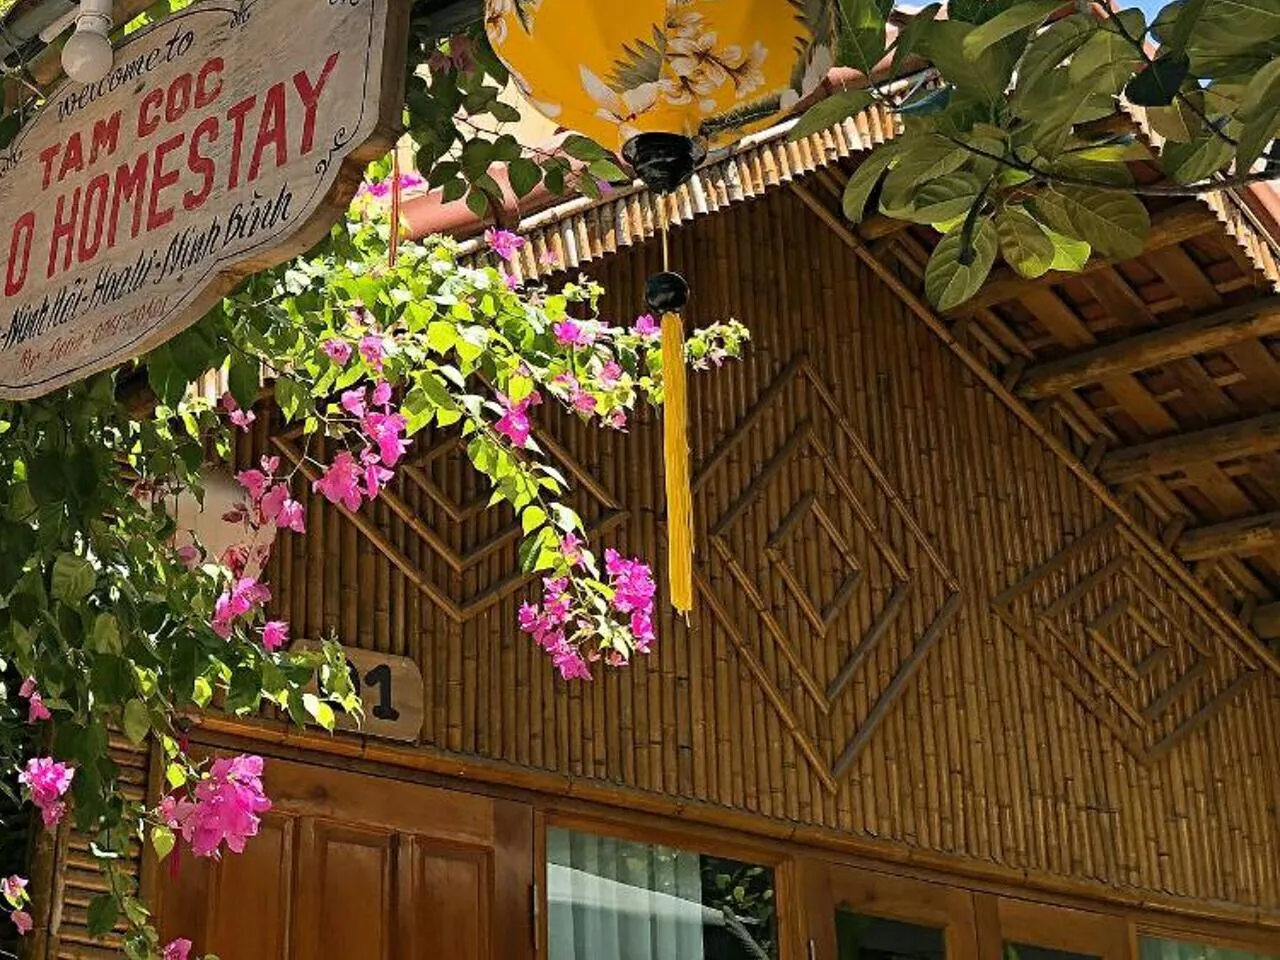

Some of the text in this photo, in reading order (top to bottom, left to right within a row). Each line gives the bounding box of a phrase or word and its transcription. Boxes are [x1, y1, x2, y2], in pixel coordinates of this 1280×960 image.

[165, 22, 194, 62] to
[39, 57, 225, 190] TAM COC
[46, 51, 340, 279] HOMESTAY
[222, 180, 293, 248] Bình
